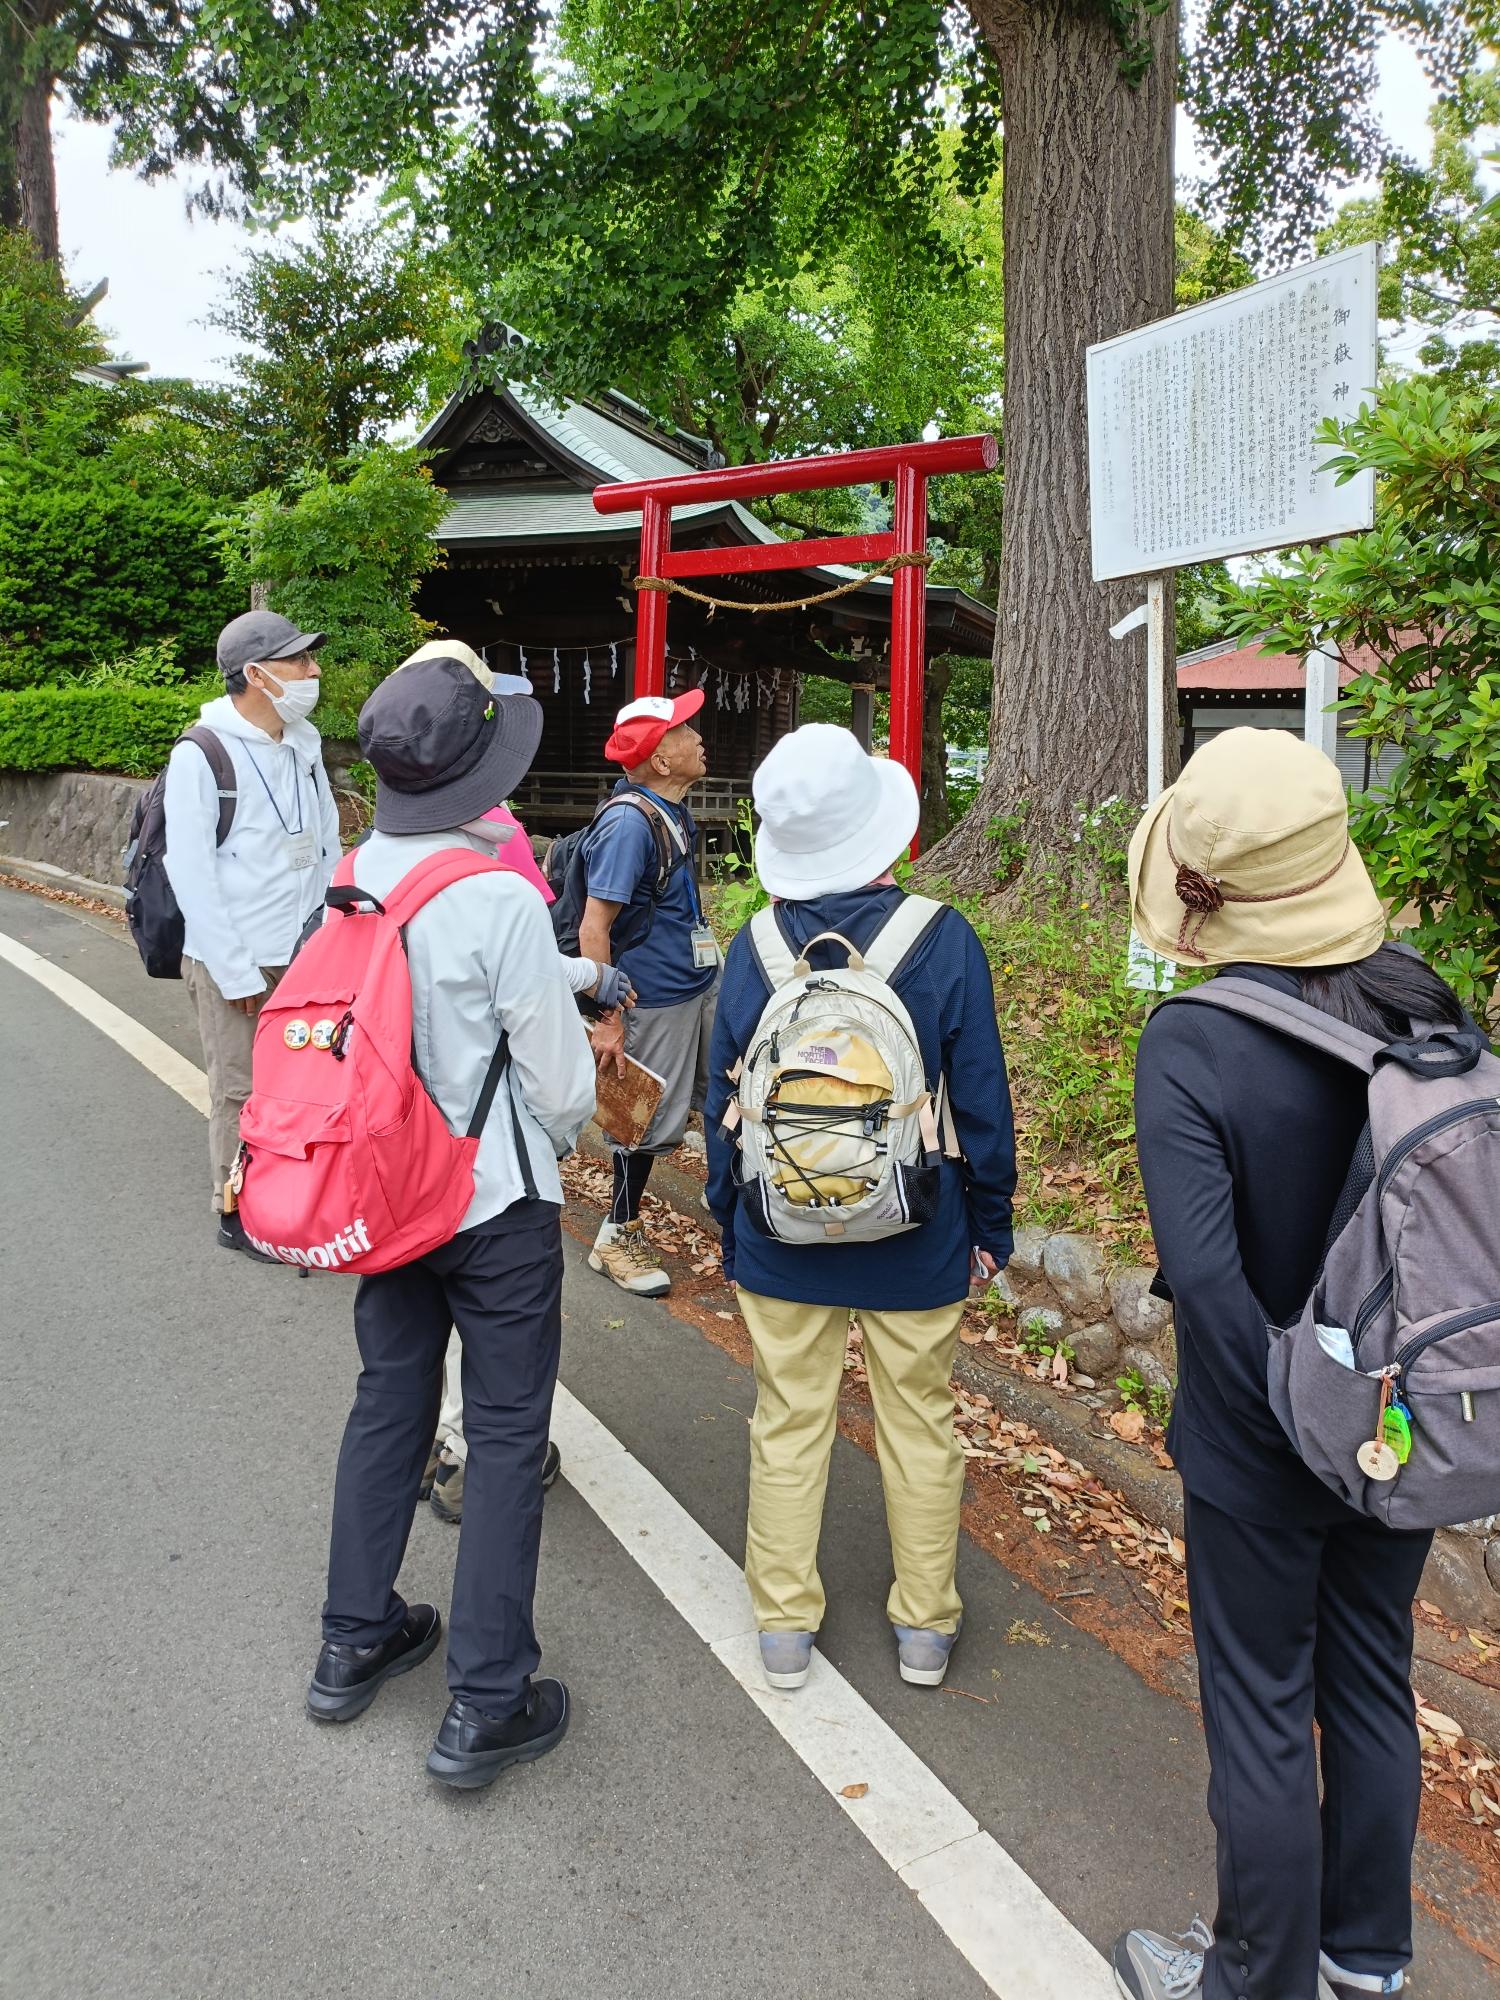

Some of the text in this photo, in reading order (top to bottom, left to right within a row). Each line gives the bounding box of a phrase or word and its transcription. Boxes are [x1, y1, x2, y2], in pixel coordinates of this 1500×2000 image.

[1332, 307, 1353, 436] 御嶽神
[797, 1051, 826, 1059] NORTH
[277, 1217, 374, 1268] sportif
